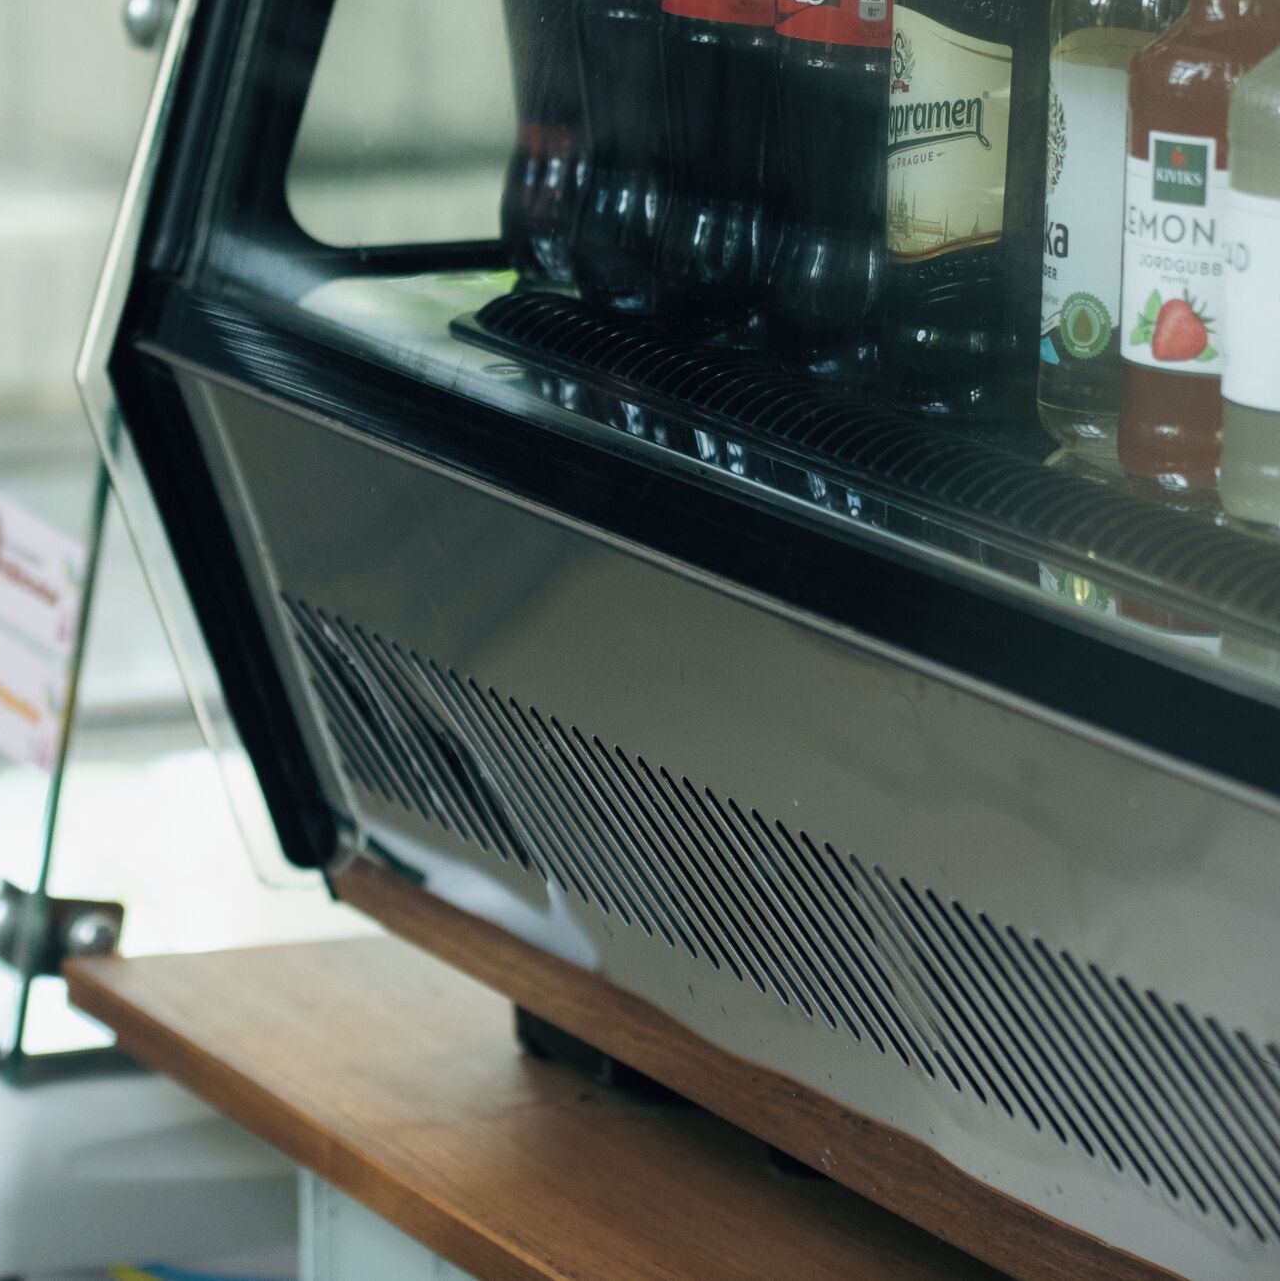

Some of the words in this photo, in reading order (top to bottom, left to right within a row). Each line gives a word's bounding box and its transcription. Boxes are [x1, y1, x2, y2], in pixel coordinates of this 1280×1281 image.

[897, 151, 934, 169] PRAGUE
[1155, 167, 1202, 187] KIVIKS
[1124, 205, 1216, 247] EMON
